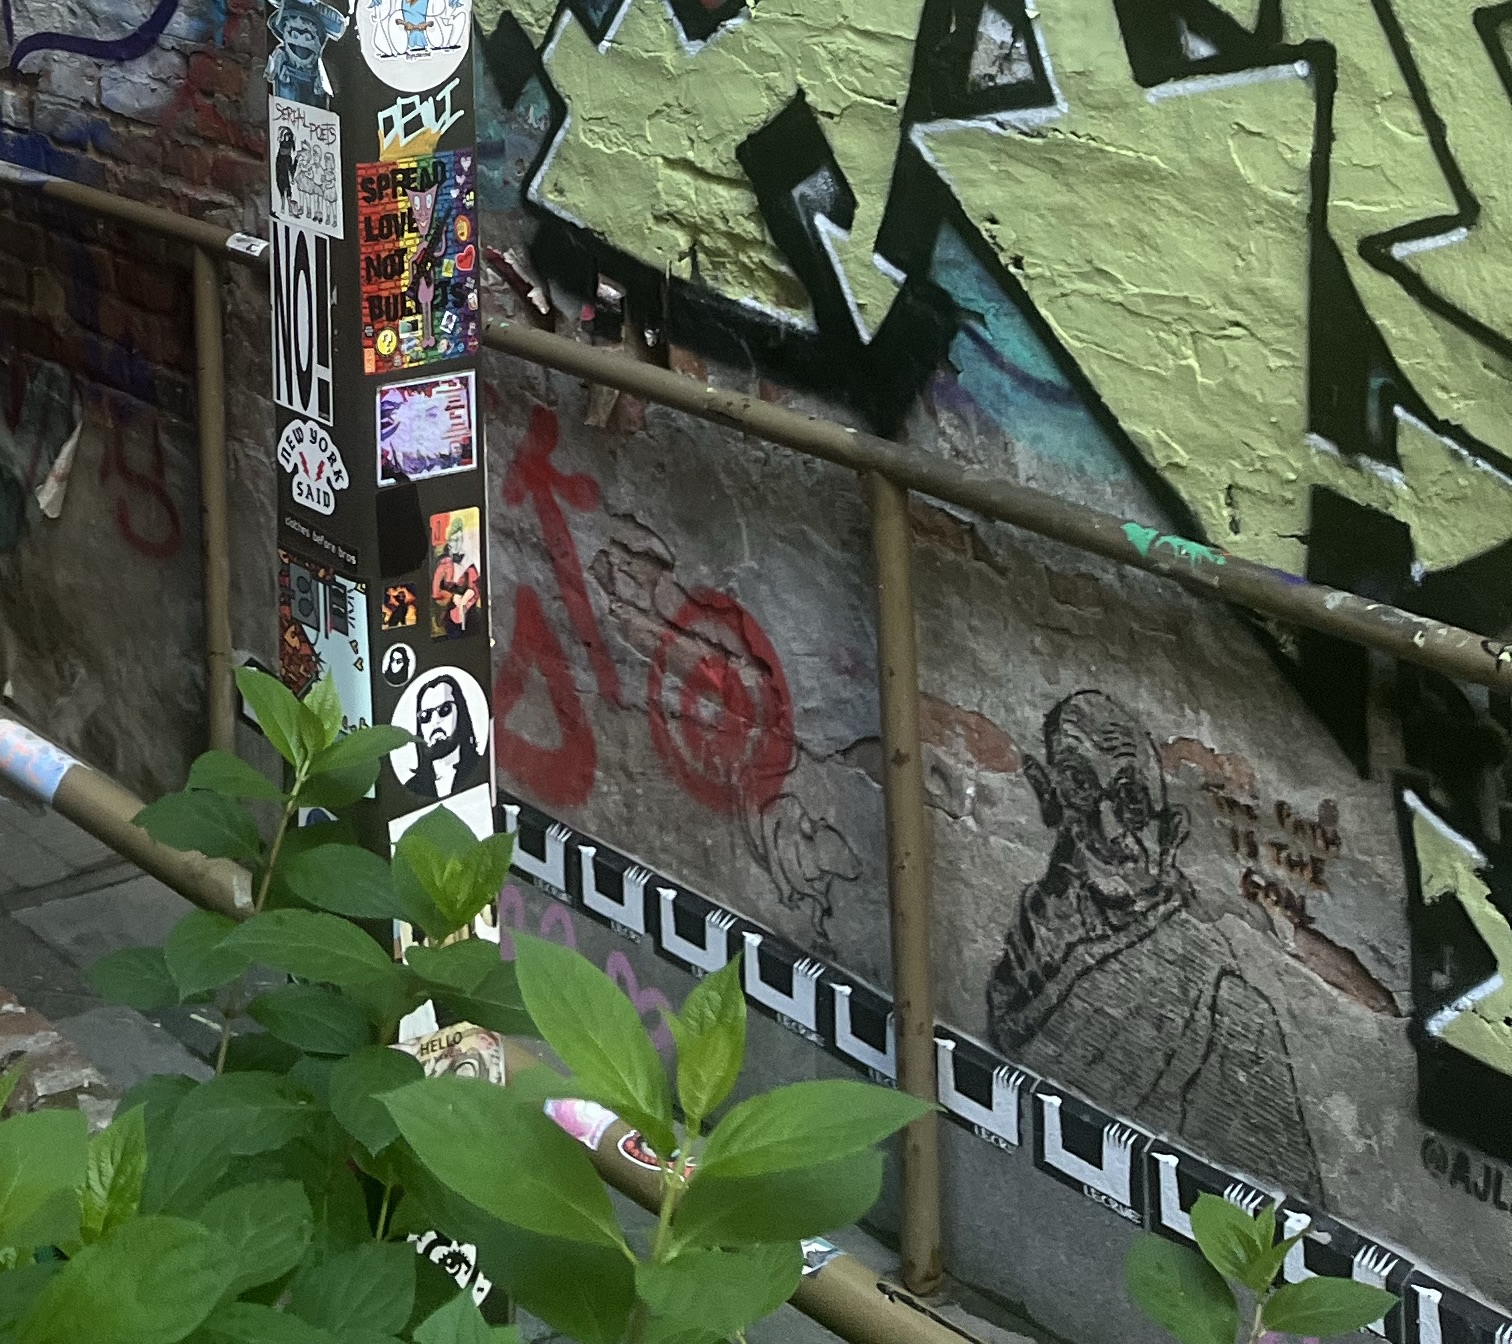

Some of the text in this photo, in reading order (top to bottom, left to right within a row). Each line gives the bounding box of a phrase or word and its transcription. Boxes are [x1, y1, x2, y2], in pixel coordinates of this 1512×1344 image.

[361, 161, 447, 204] SPREAD
[363, 210, 419, 243] LOVE
[364, 248, 408, 284] NOT
[280, 425, 345, 484] NEW YORK
[296, 480, 331, 509] SAID
[420, 1031, 463, 1057] HELLO
